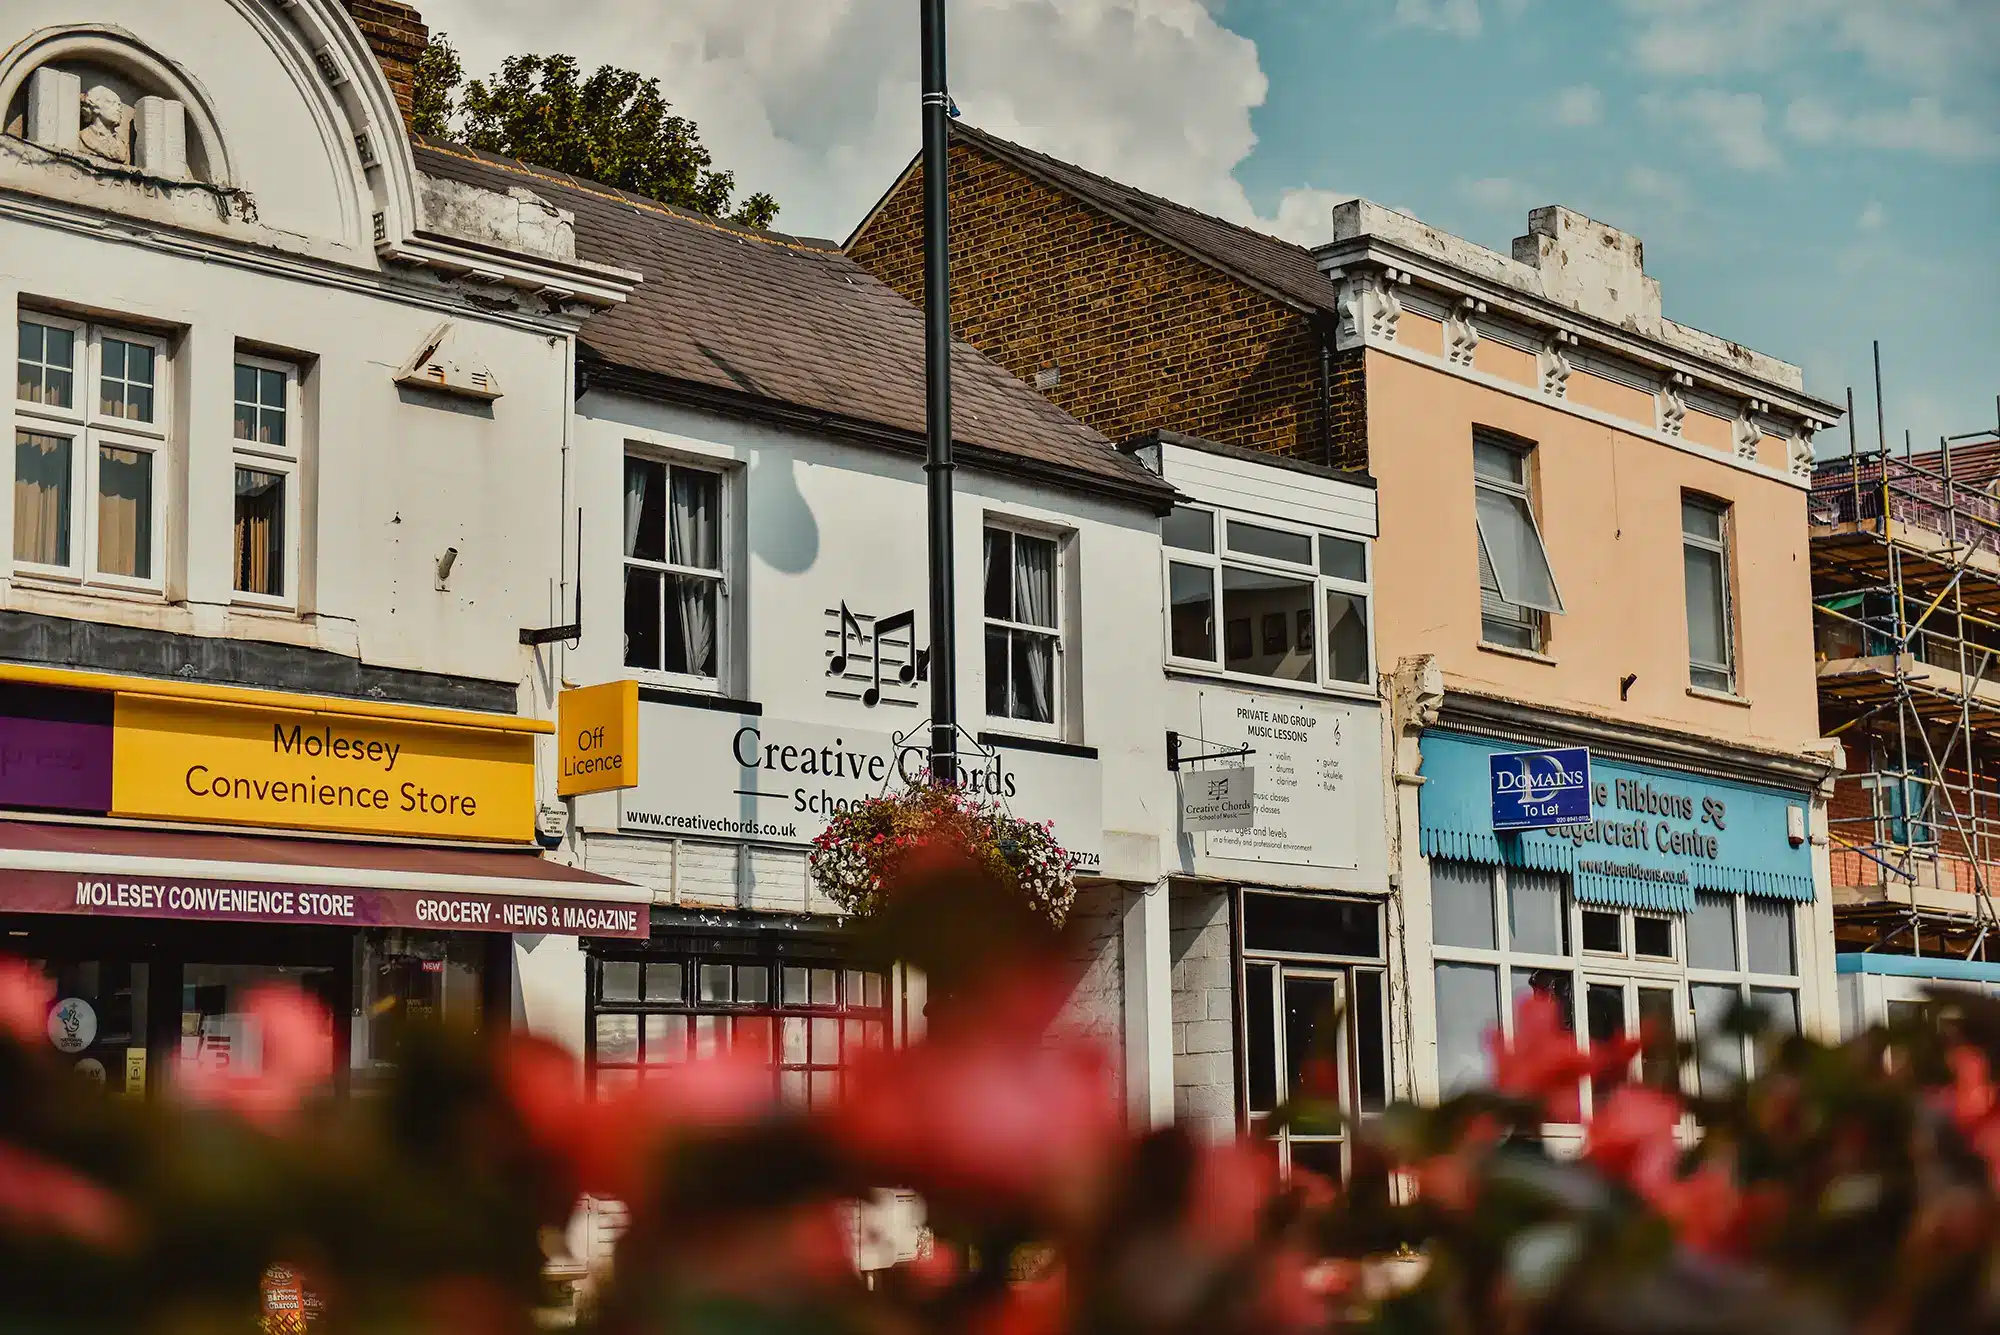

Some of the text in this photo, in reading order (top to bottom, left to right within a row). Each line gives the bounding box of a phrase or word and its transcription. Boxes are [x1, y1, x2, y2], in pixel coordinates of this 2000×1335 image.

[1236, 707, 1316, 728] PRIVATE AND GROUP
[578, 726, 605, 751] Off
[1247, 725, 1308, 742] MUSIC LESSONS
[273, 723, 401, 772] Molesey
[732, 726, 1016, 797] Creative Cords
[1275, 752, 1292, 762] violin
[1322, 758, 1339, 768] guitar
[564, 754, 623, 777] Licence
[1276, 764, 1295, 774] drums
[1276, 776, 1298, 787] clarinet
[1322, 770, 1344, 781] ukulele
[185, 764, 477, 817] Convenience Store
[1323, 781, 1336, 791] flute
[794, 787, 869, 815] Schoo
[1269, 792, 1290, 803] classes
[1615, 778, 1693, 820] Ribbons
[1185, 803, 1220, 815] Creative
[1221, 799, 1251, 812] Chords
[1260, 804, 1281, 814] classes
[1523, 803, 1559, 817] To Let
[626, 810, 797, 838] www.creativechords.co.uk
[1198, 813, 1217, 821] School
[1222, 812, 1238, 820] Music
[1253, 826, 1267, 837] and
[1268, 826, 1288, 838] levels
[1545, 819, 1719, 860] ugarcraft Centre
[1223, 836, 1242, 846] friendly
[1242, 839, 1253, 847] and
[1253, 839, 1282, 849] professional
[1283, 842, 1312, 851] environment
[1577, 859, 1690, 886] www.blueribbons.co.uk
[76, 881, 354, 917] MOLESEY CONVENIENCE STORE
[415, 899, 492, 924] GROCERY
[503, 904, 548, 926] NEWS
[551, 906, 561, 927] &
[563, 907, 637, 931] MAGAZINE
[423, 962, 441, 970] NEW
[268, 1301, 299, 1310] Charcoal
